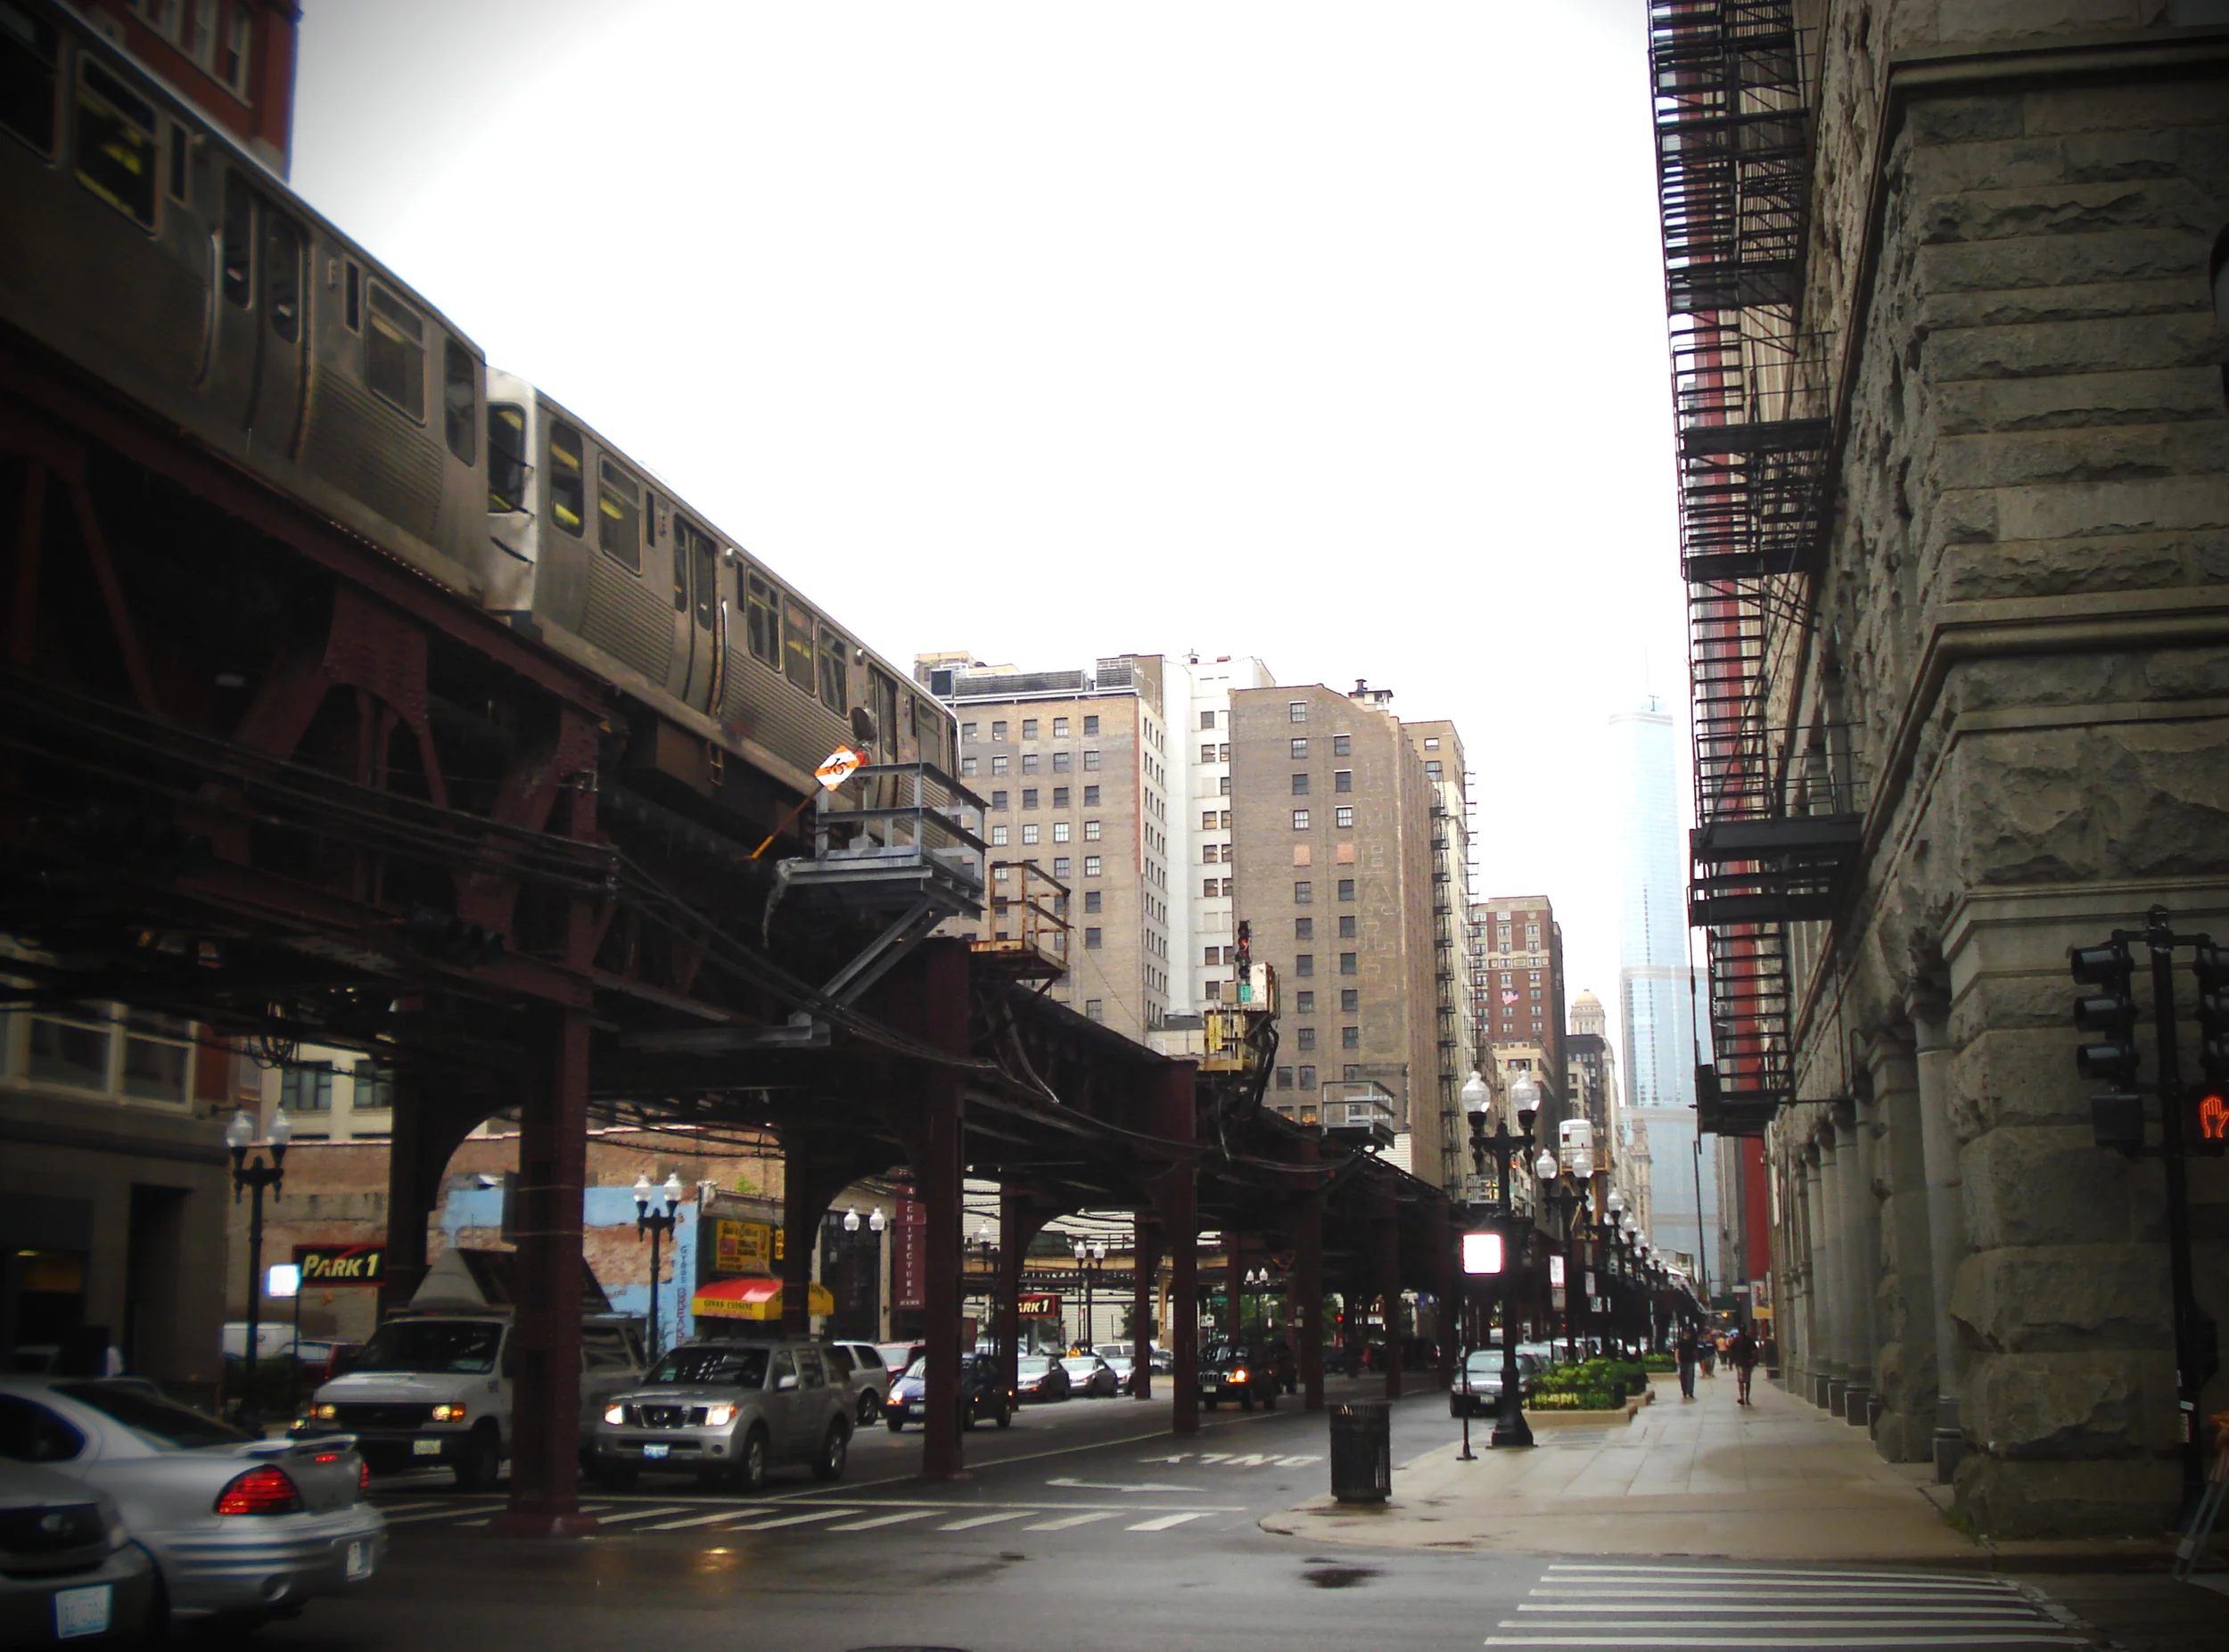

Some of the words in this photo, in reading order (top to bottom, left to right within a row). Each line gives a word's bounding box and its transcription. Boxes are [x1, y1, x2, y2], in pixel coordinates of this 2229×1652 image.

[906, 1188, 914, 1297] ACHITECTURE
[302, 1254, 363, 1277] PARK
[366, 1253, 379, 1277] 1
[1017, 1302, 1040, 1312] ARK
[1042, 1299, 1049, 1312] 1
